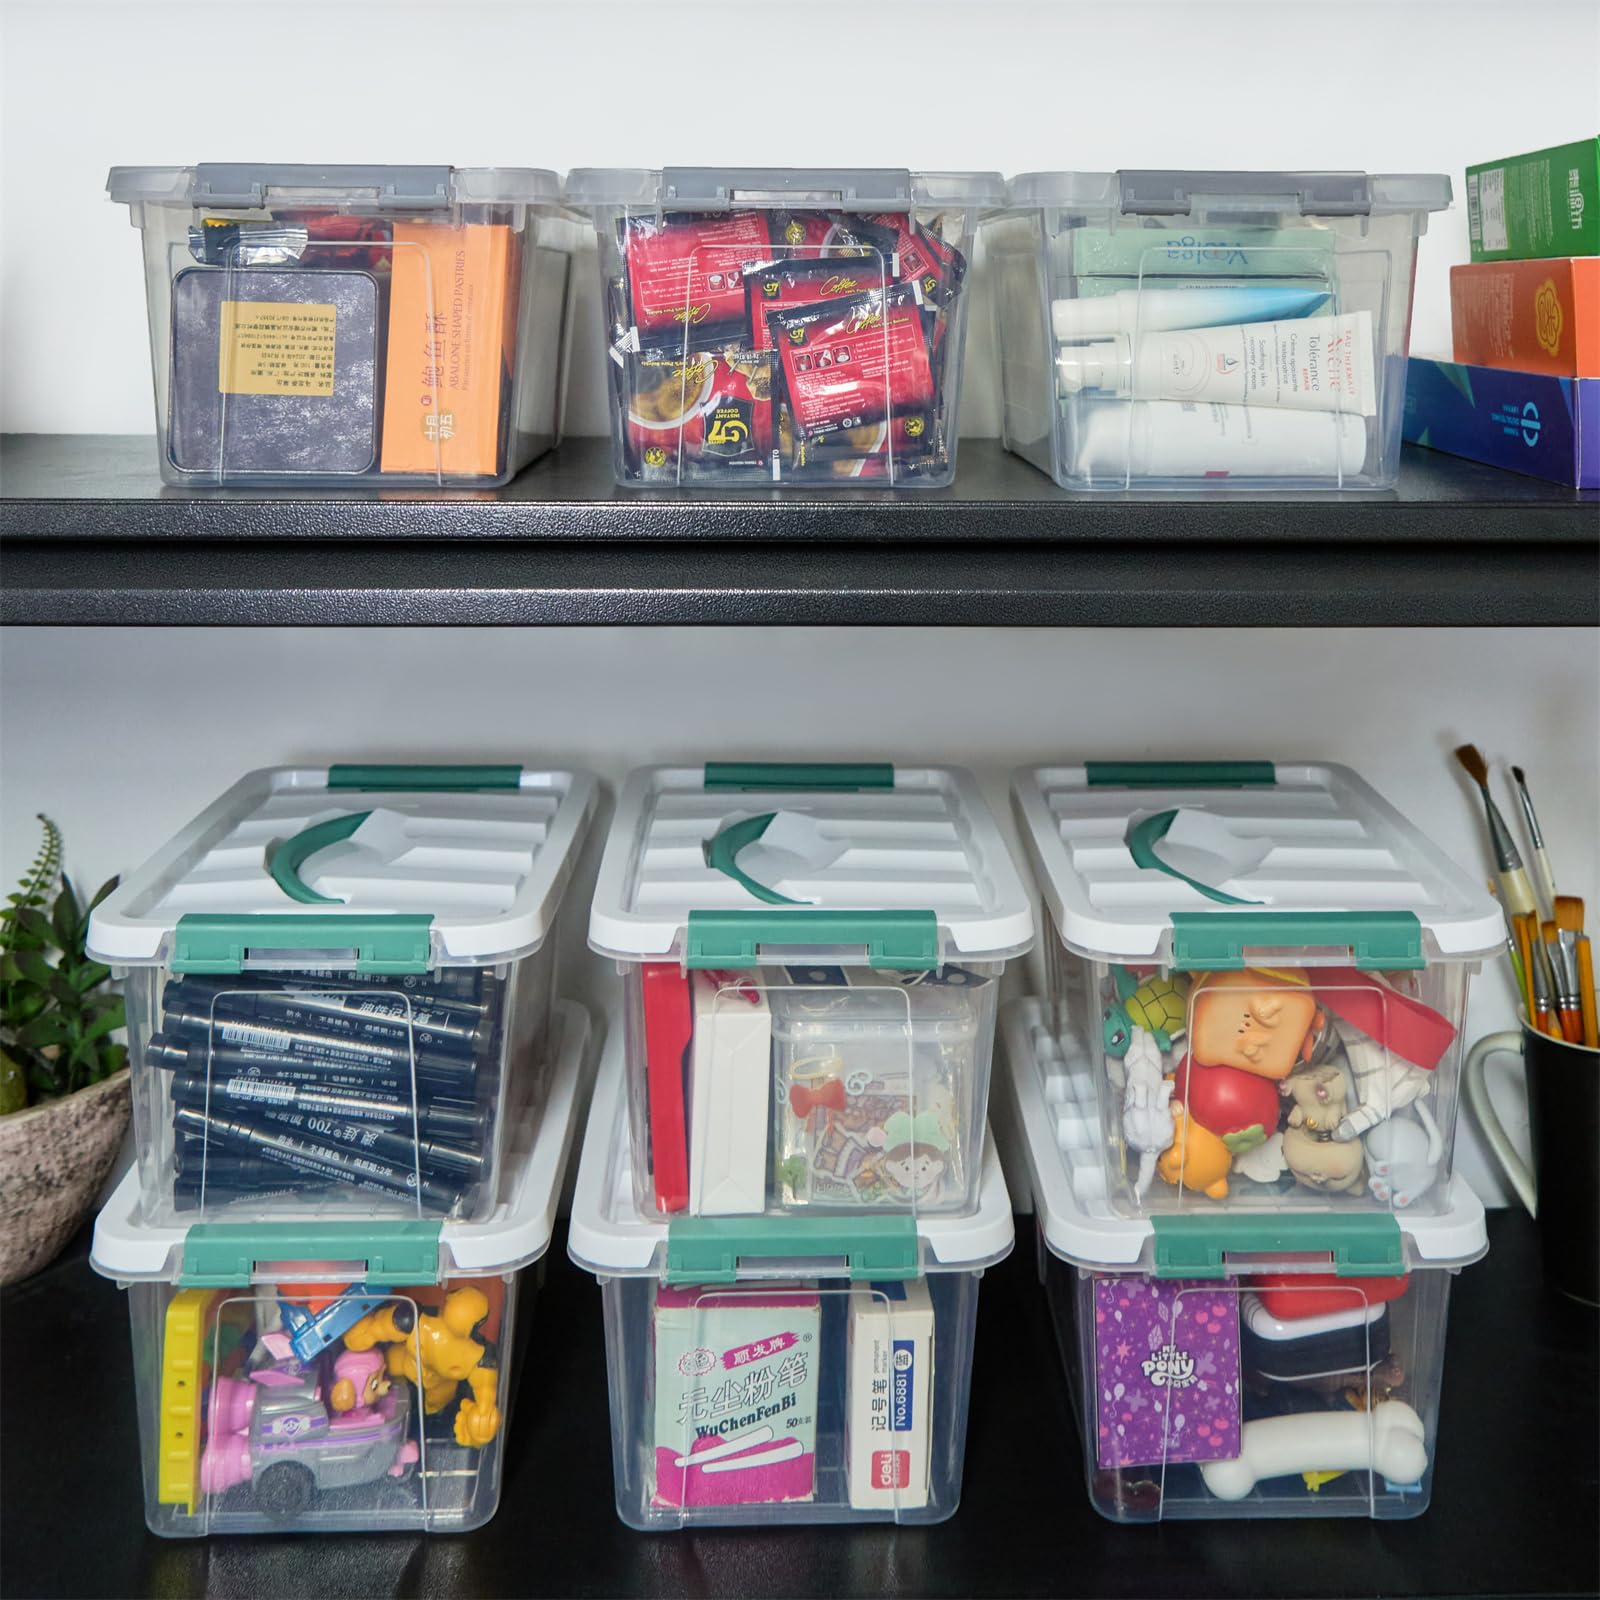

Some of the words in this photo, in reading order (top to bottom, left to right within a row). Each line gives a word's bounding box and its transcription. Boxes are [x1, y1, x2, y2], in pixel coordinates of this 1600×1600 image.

[454, 250, 465, 296] PASTRIES
[819, 275, 858, 296] Coffee
[451, 298, 463, 338] SHAPED
[673, 303, 711, 323] Coffee
[449, 342, 460, 390] ABALONE
[672, 360, 718, 383] Coffee
[1308, 335, 1320, 391] Tolérance
[708, 420, 749, 443] G7
[307, 1117, 332, 1134] 700
[1141, 1359, 1194, 1386] PONY
[695, 1392, 796, 1439] WuChenFenBi
[872, 1378, 887, 1431] 记号笔
[896, 1374, 907, 1427] No.6881
[880, 1454, 892, 1485] deli
